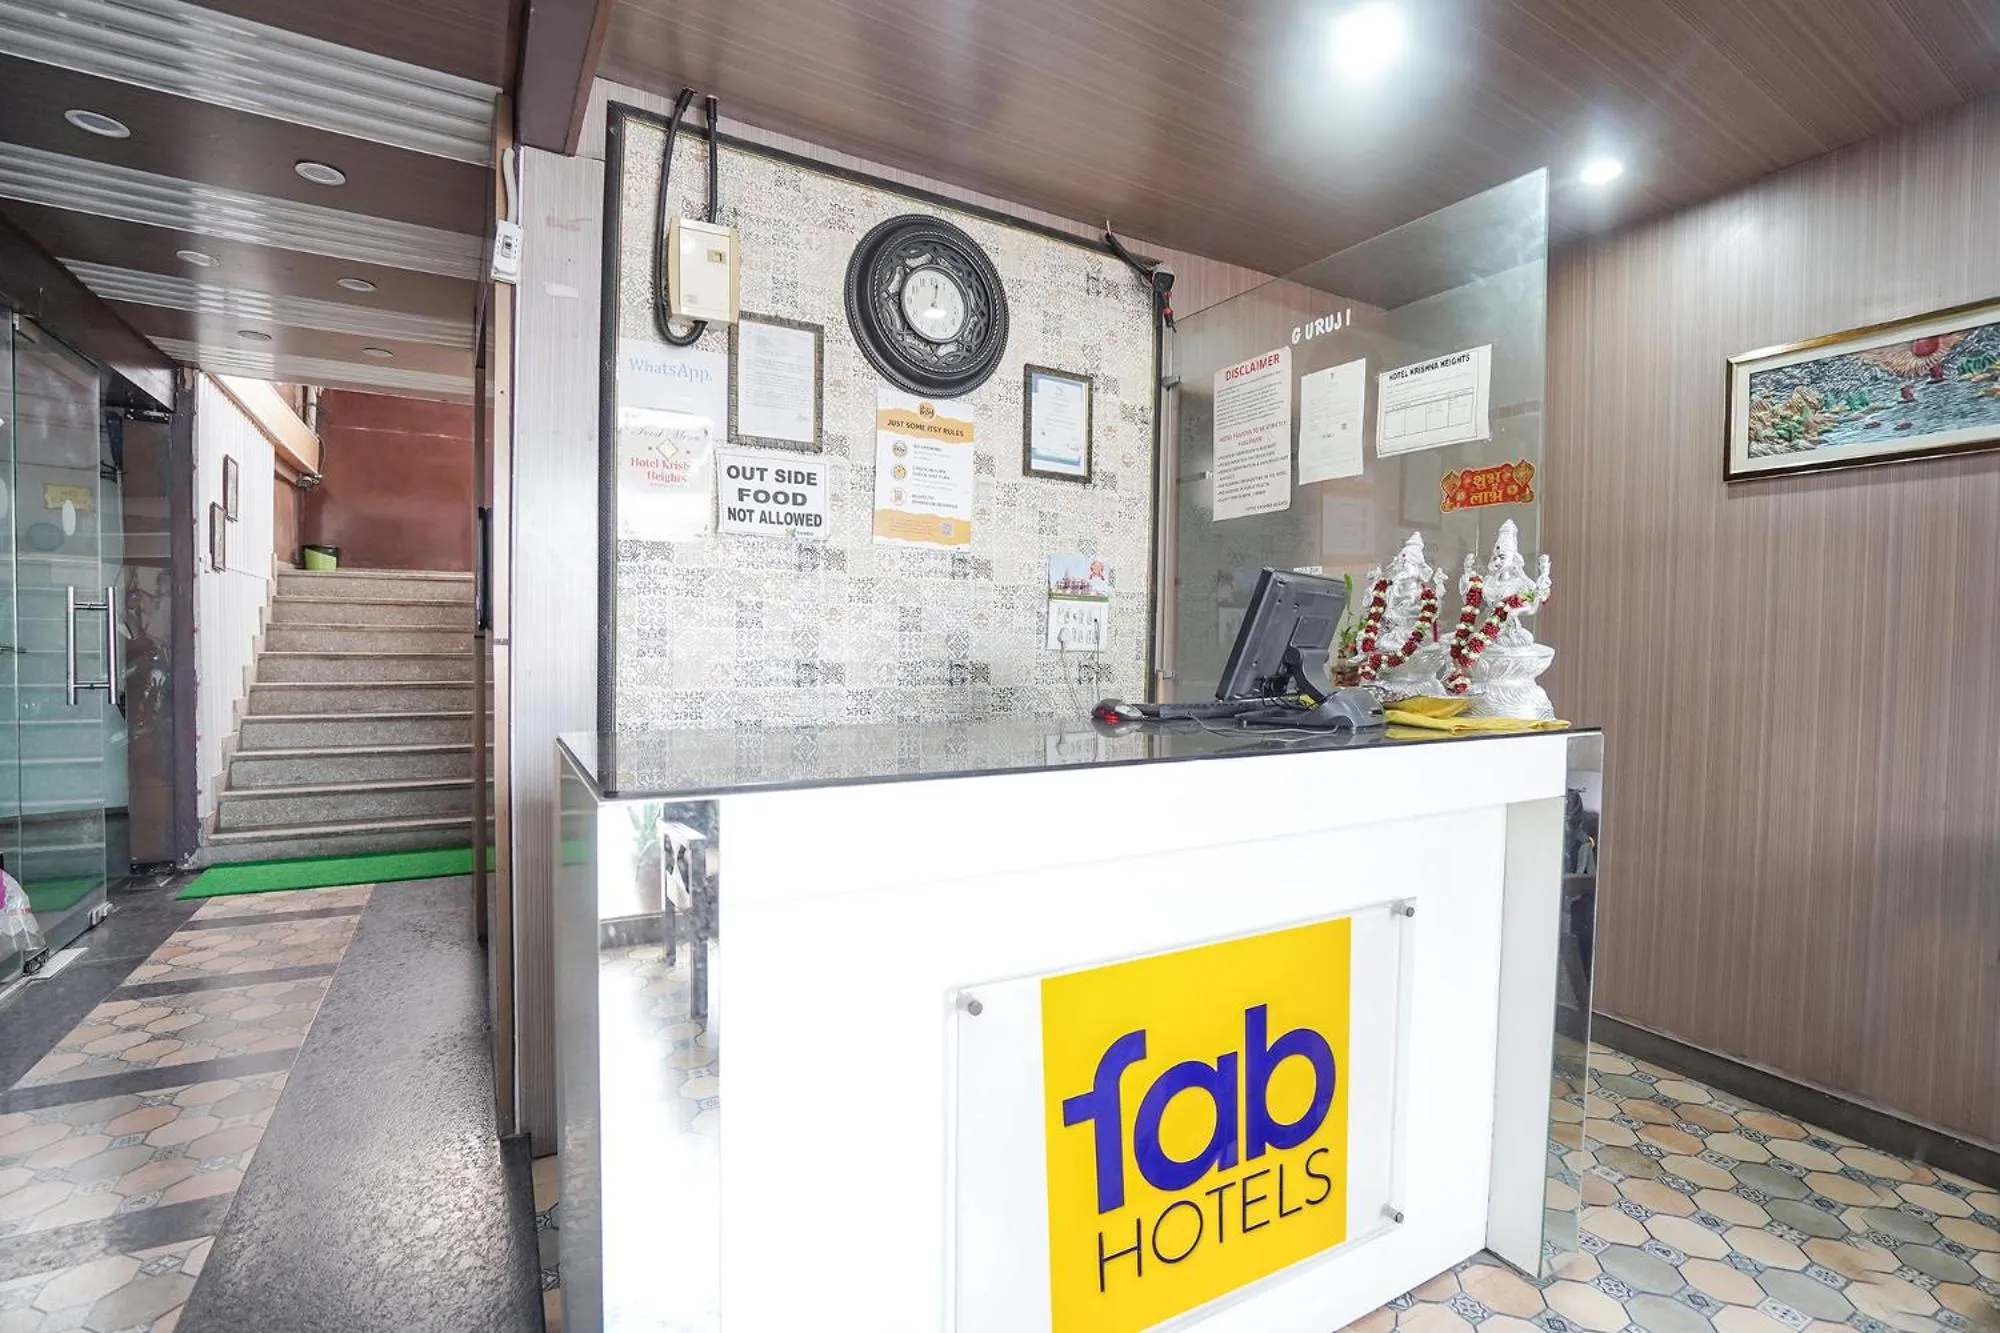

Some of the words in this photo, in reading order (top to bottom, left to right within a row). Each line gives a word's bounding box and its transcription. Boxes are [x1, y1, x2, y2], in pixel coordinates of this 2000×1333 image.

[1225, 353, 1281, 381] DISCLAIMER
[1389, 369, 1409, 381] HOTEL
[1410, 362, 1439, 376] KRISHNA
[1440, 353, 1470, 367] HEIGHTS
[887, 419, 904, 428] JUST
[906, 421, 925, 431] SOME
[927, 425, 941, 433] ITSY
[943, 426, 964, 437] RULES
[631, 457, 659, 468] Hotel
[647, 470, 687, 484] Heights
[726, 465, 768, 482] OUT
[774, 468, 818, 486] SIDE
[738, 487, 807, 506] FOOD
[727, 507, 754, 523] NOT
[759, 510, 822, 527] ALLOWED
[1062, 1003, 1336, 1215] fab
[1098, 1147, 1332, 1293] HOTELS
